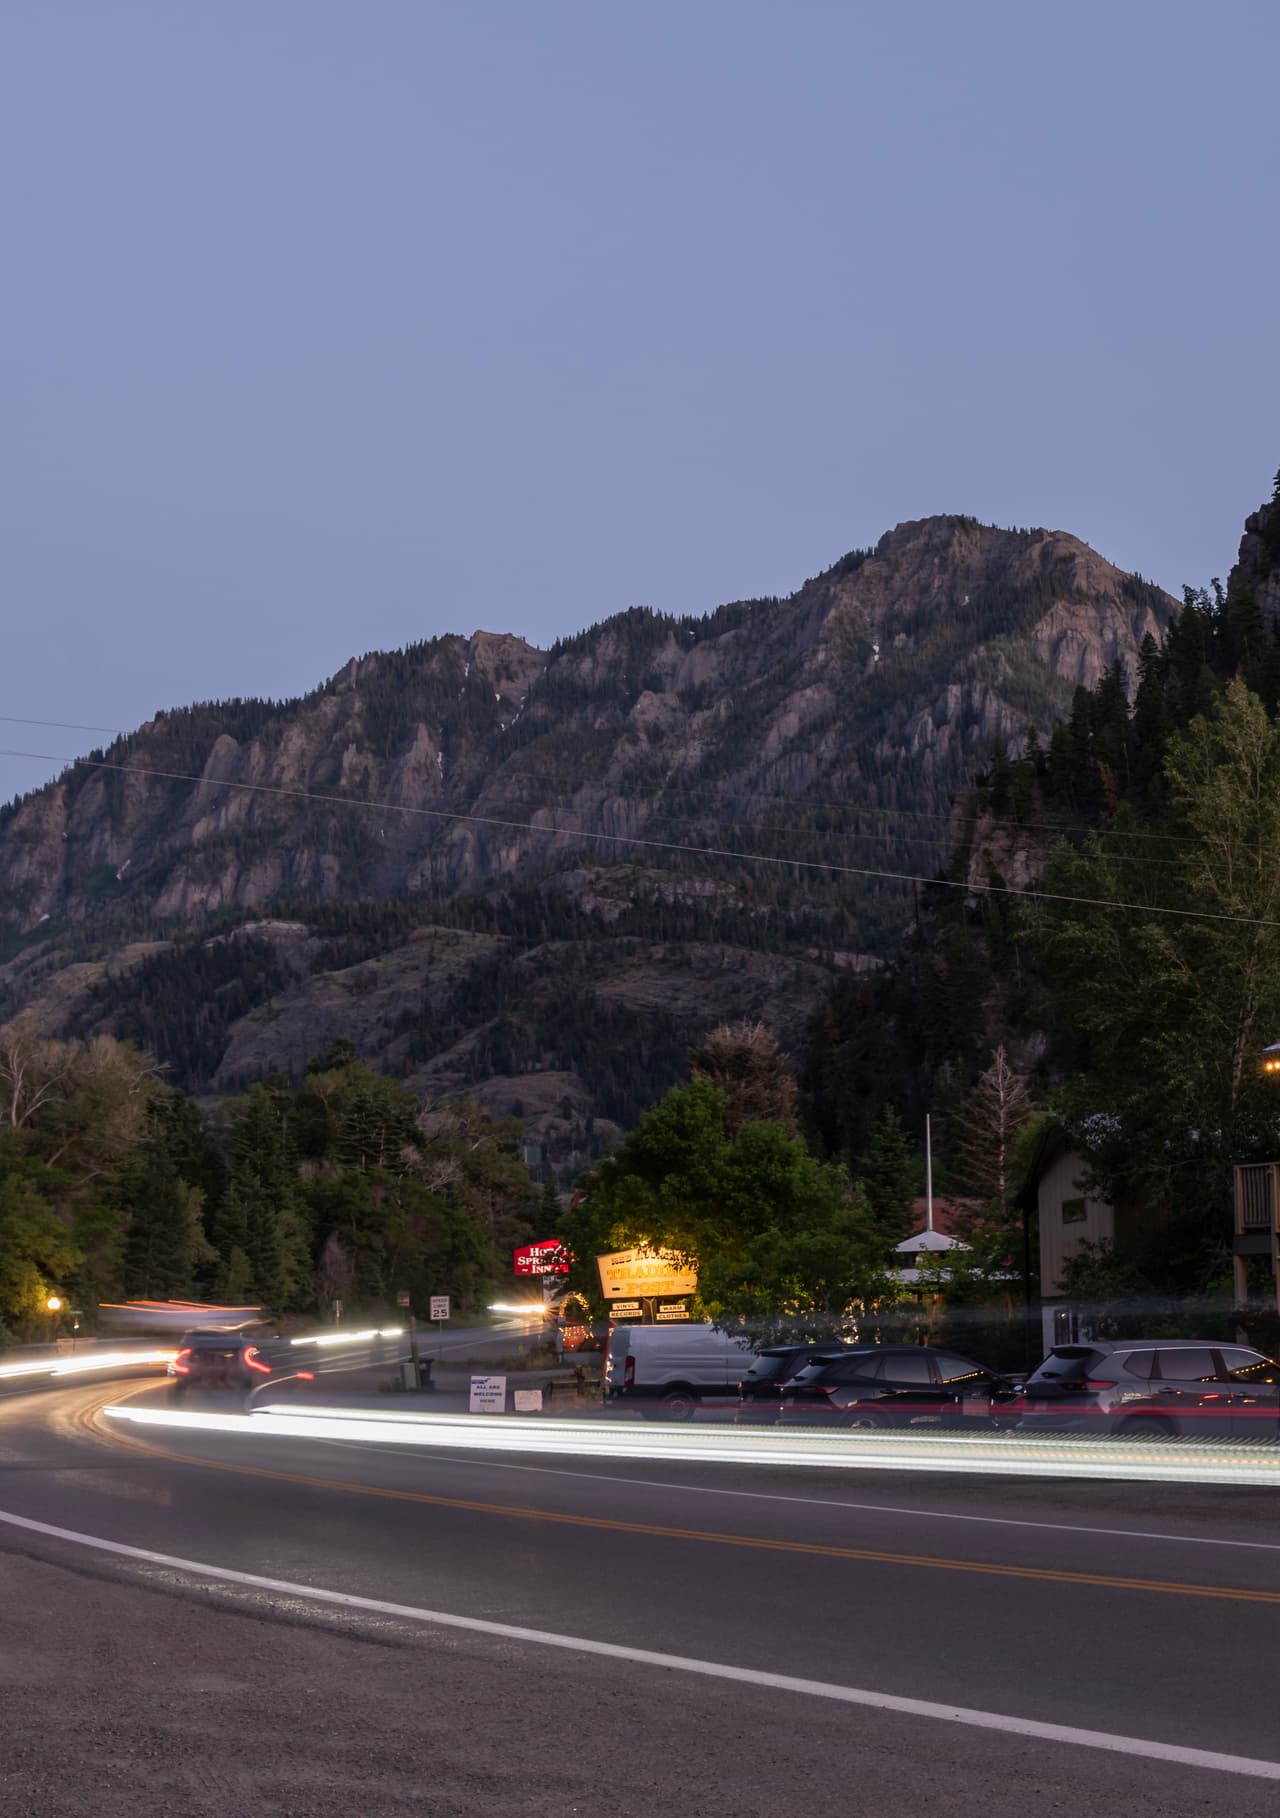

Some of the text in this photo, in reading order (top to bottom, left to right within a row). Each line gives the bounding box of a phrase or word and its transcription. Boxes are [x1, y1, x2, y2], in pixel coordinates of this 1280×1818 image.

[531, 1264, 552, 1274] INN
[626, 1281, 674, 1294] POST
[433, 1309, 448, 1318] 25
[658, 1311, 687, 1319] CLOTHES
